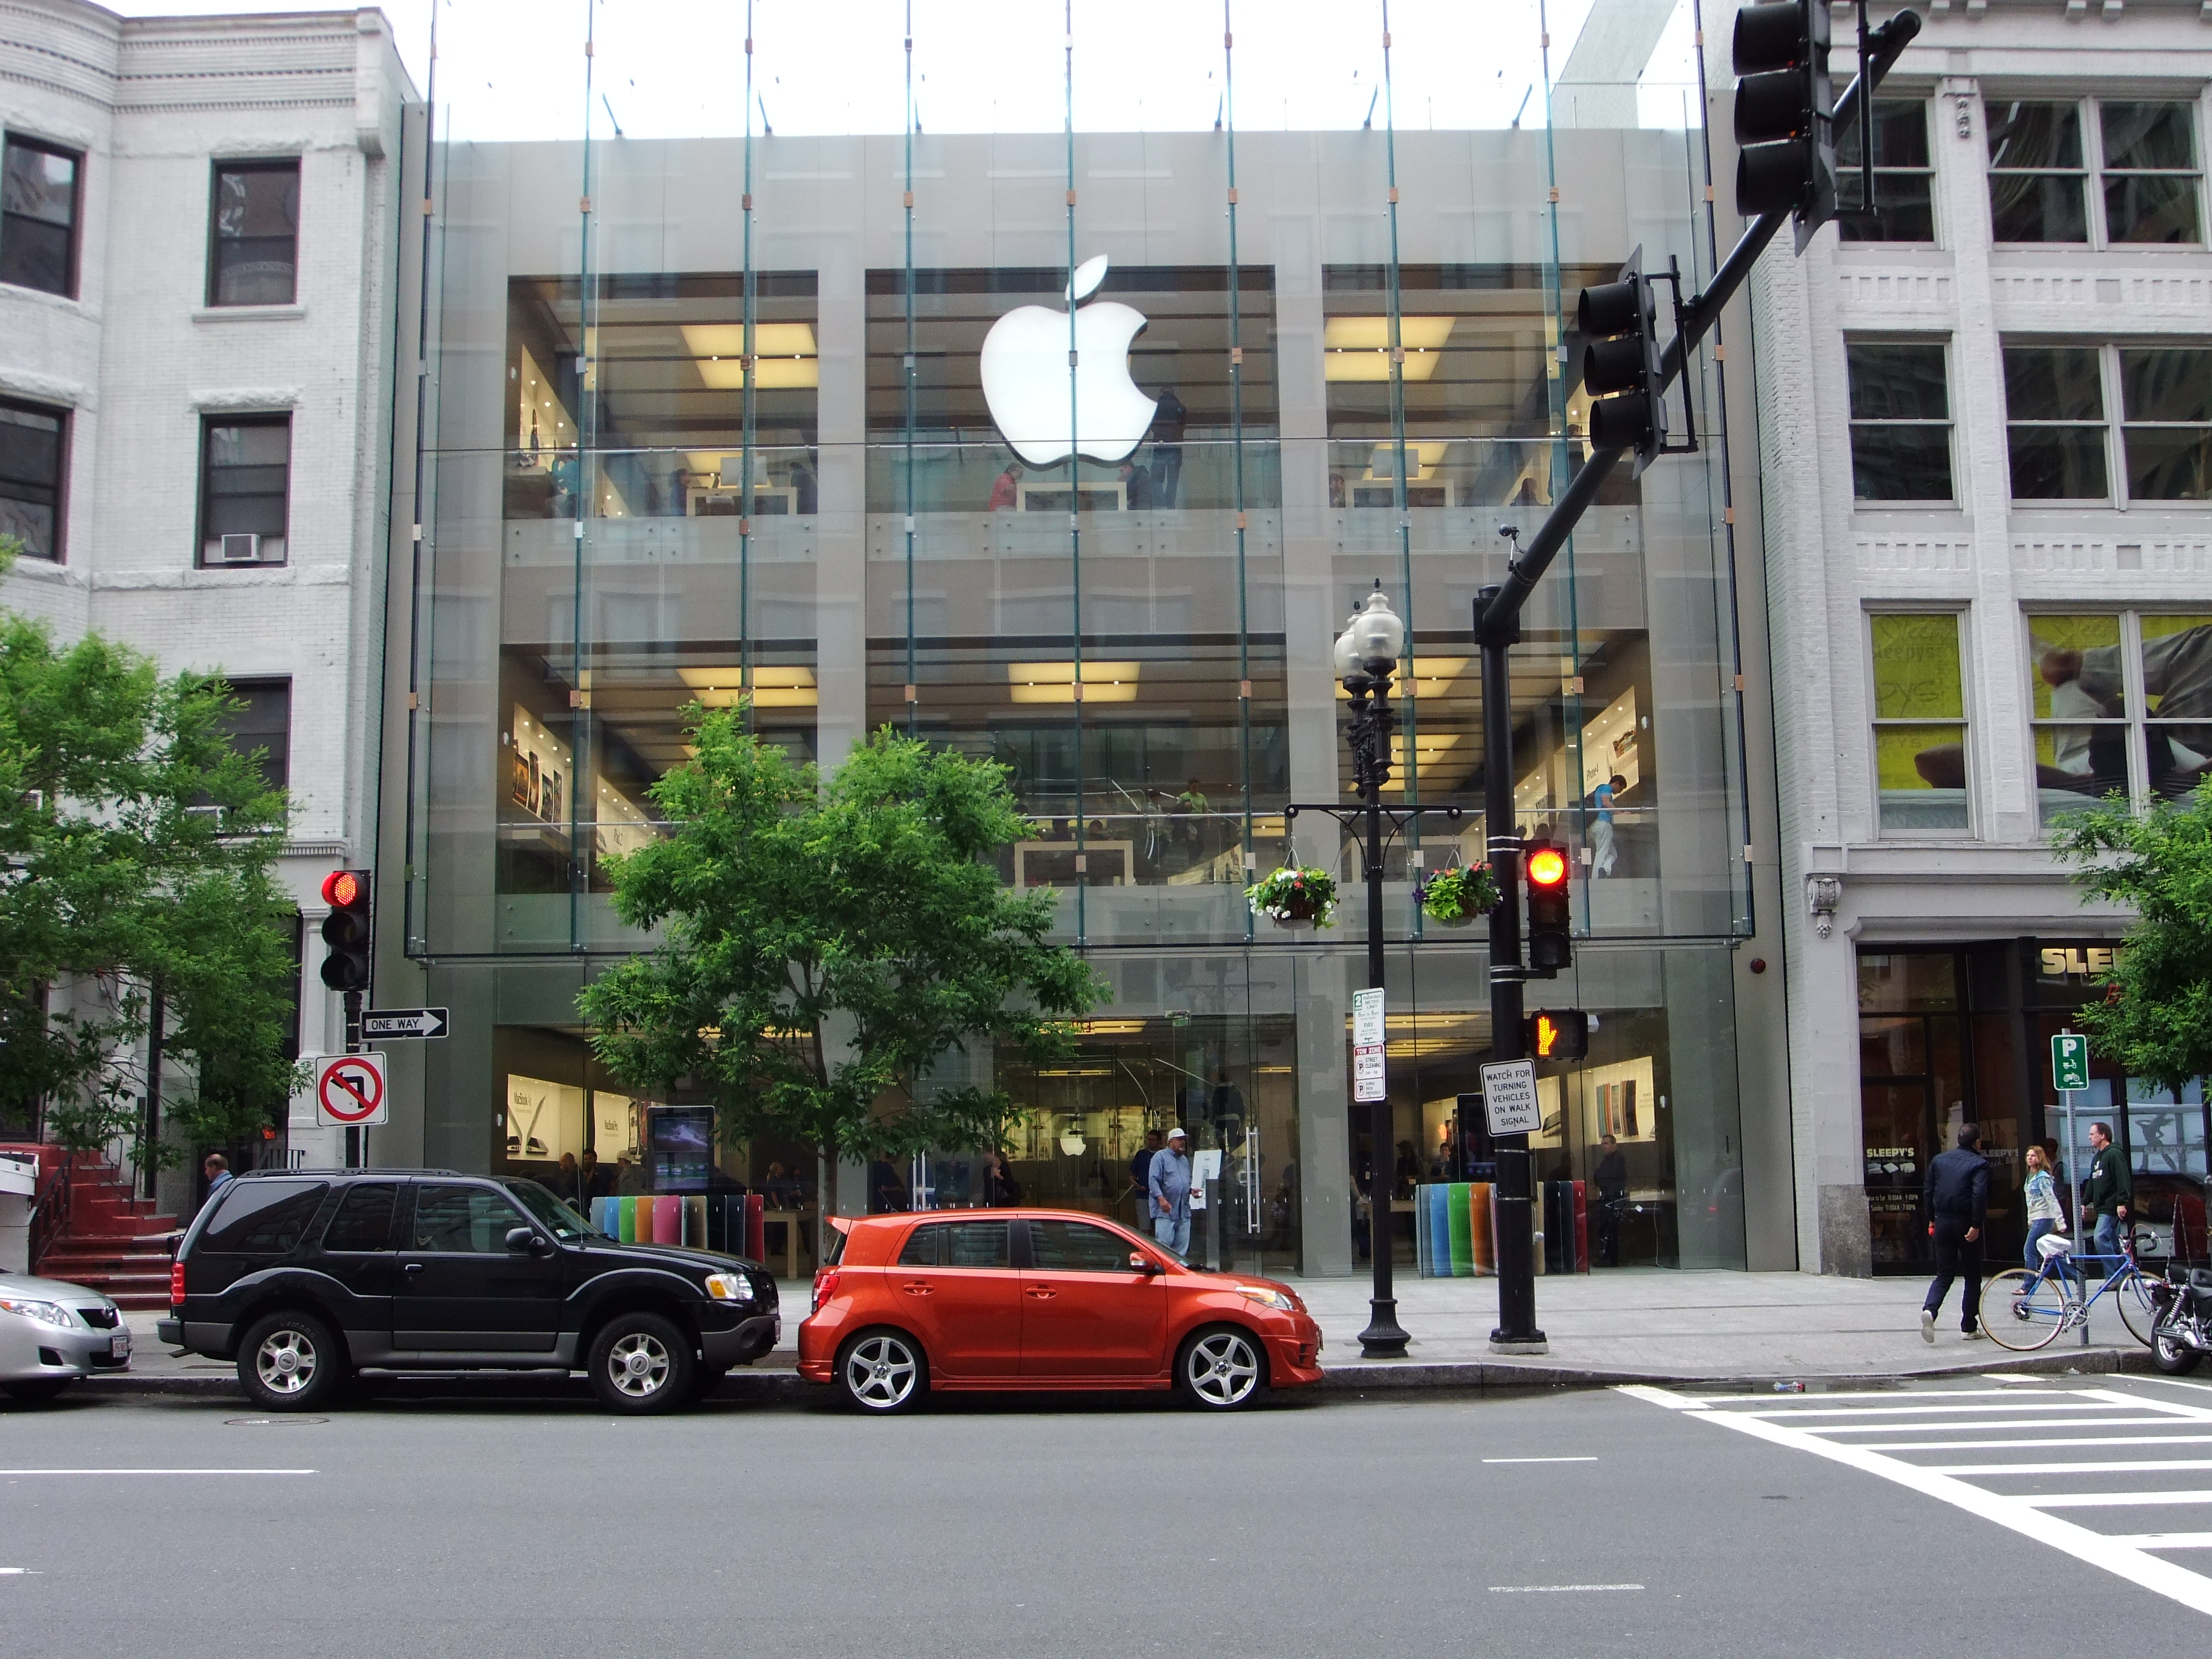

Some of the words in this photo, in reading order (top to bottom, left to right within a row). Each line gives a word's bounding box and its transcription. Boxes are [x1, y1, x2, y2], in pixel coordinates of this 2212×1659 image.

[1355, 995, 1361, 1006] 2
[372, 1019, 392, 1030] ONE
[398, 1019, 419, 1029] WAY
[2062, 1039, 2077, 1057] P
[1486, 1071, 1512, 1081] WATCH
[1493, 1081, 1527, 1092] TURNING
[514, 1092, 528, 1106] MacBook
[1493, 1092, 1530, 1103] VEHICLES
[1509, 1103, 1531, 1112] WALK
[1501, 1116, 1529, 1126] SIGNAL
[1866, 1147, 1914, 1157] SLEEPY'S
